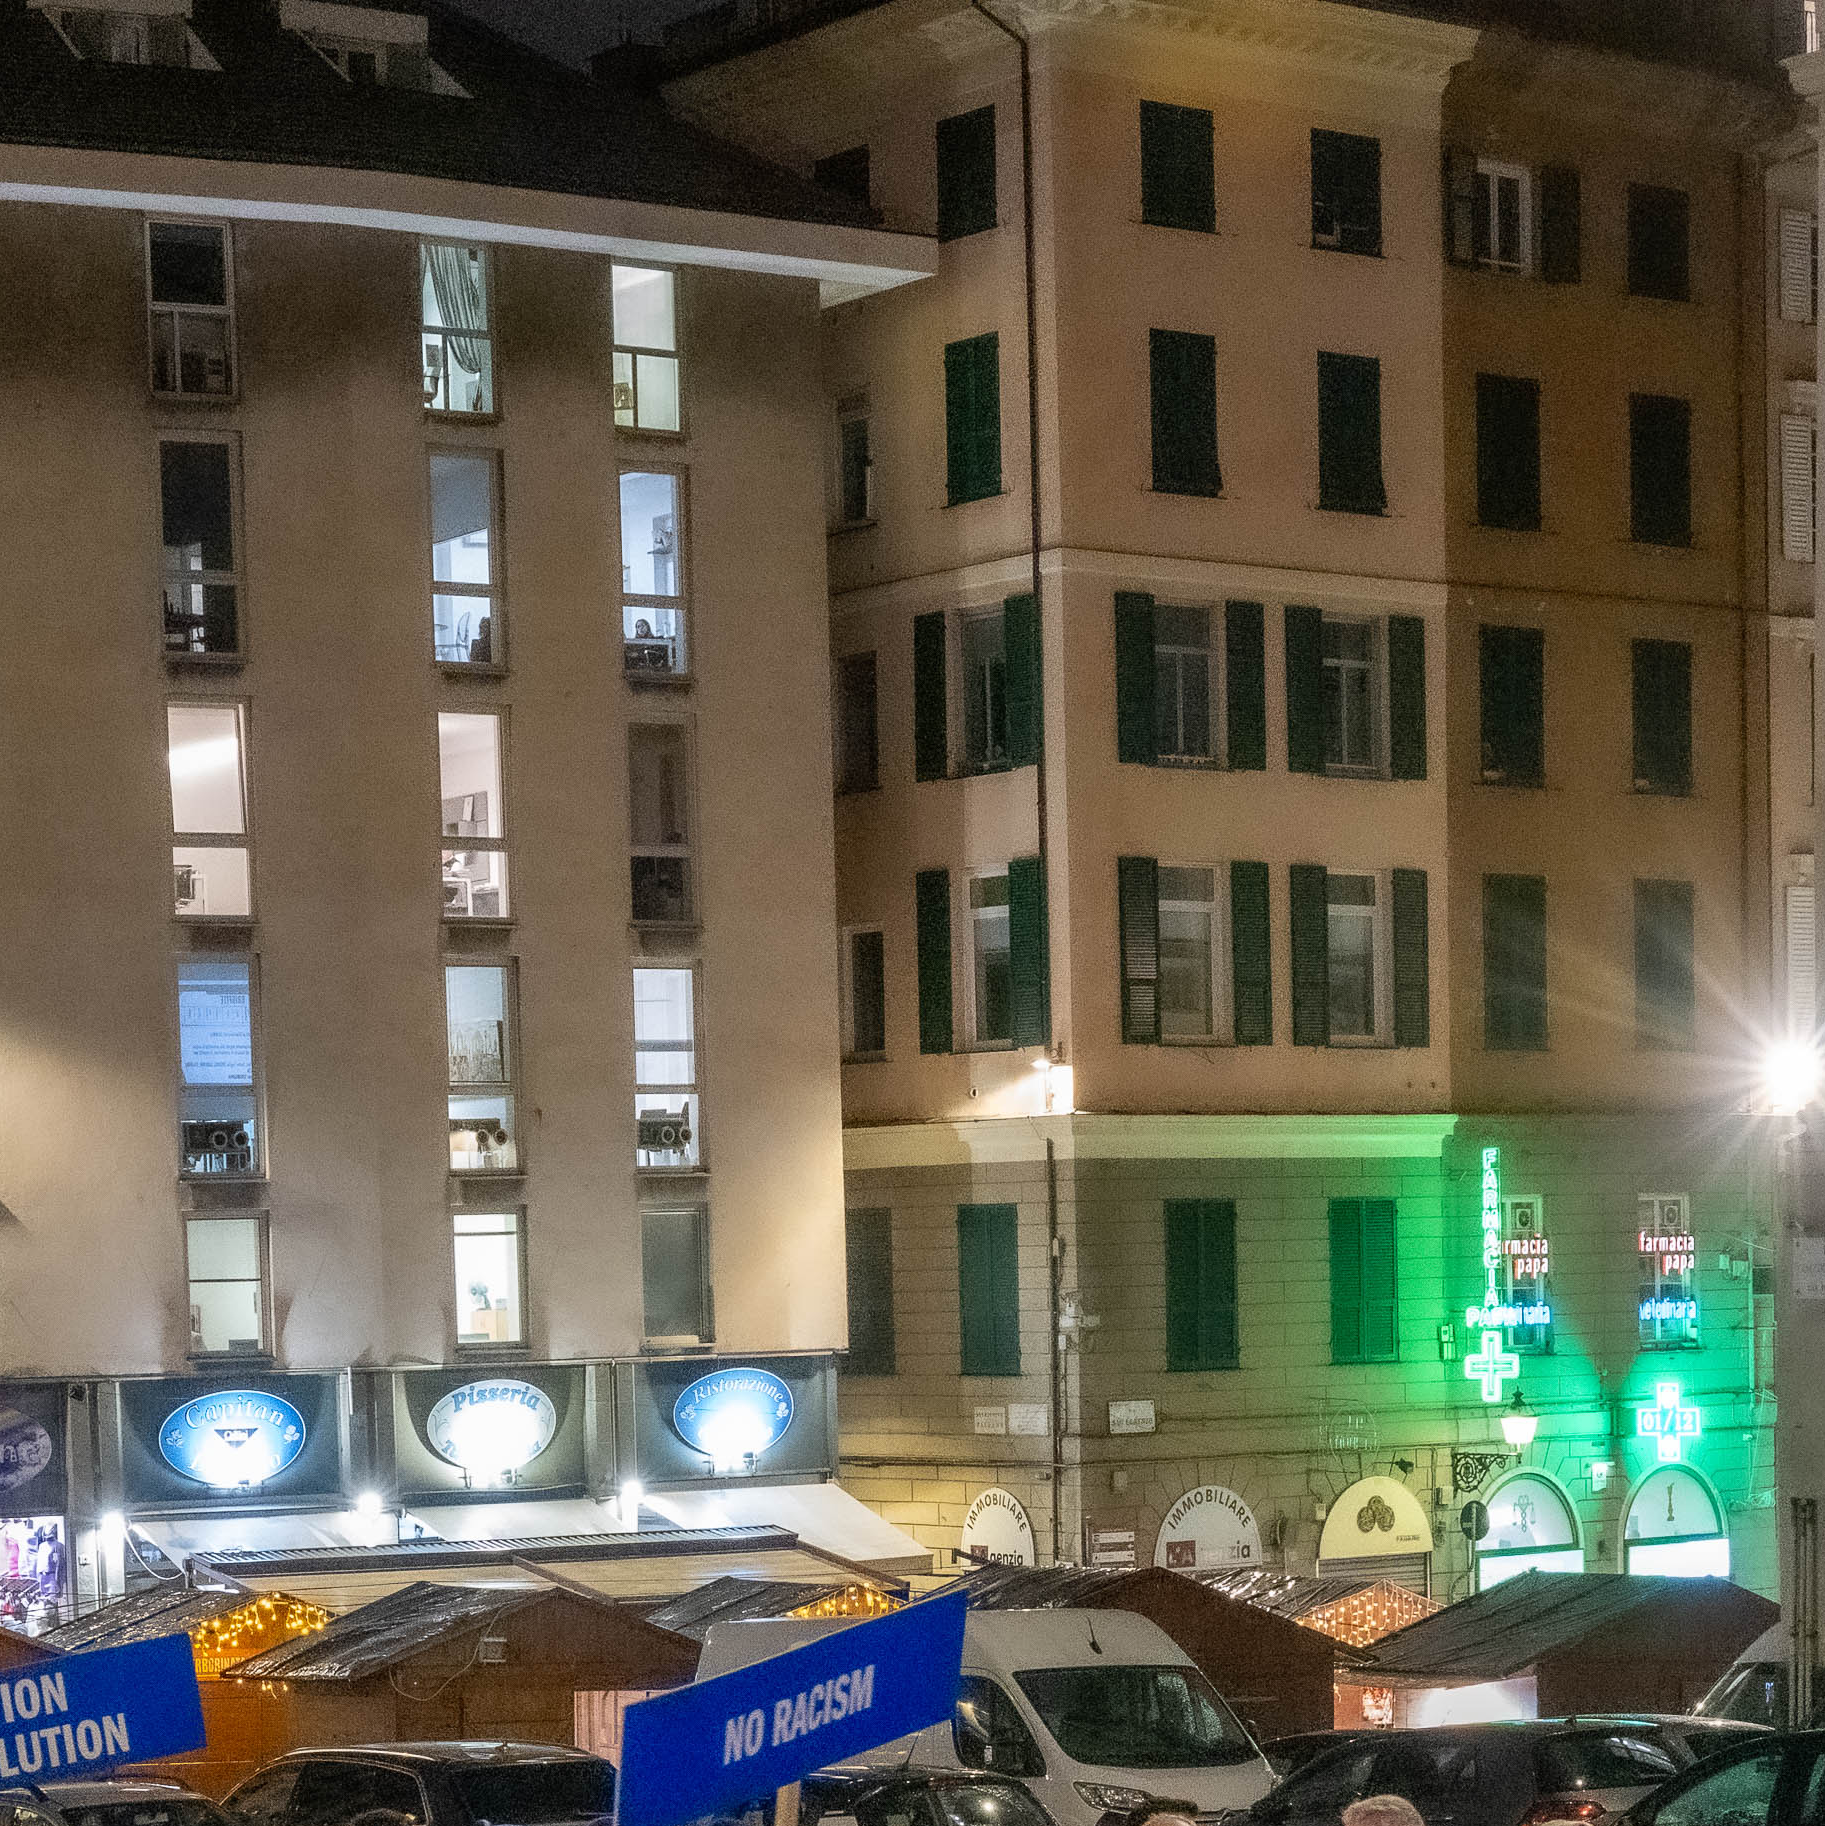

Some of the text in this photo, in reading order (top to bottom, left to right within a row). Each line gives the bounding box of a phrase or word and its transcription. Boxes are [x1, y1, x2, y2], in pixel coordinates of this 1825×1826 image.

[1481, 1148, 1500, 1307] FARMACIA
[1639, 1230, 1695, 1252] farmacia
[1513, 1256, 1548, 1279] papa
[1662, 1253, 1695, 1275] papa
[693, 1376, 784, 1405] Ristorazione
[1643, 1410, 1694, 1432] 01/12
[967, 1493, 1027, 1532] IMMOBILIARE
[1168, 1489, 1250, 1530] IMMOBILIARE
[724, 1664, 875, 1766] NO RACISM
